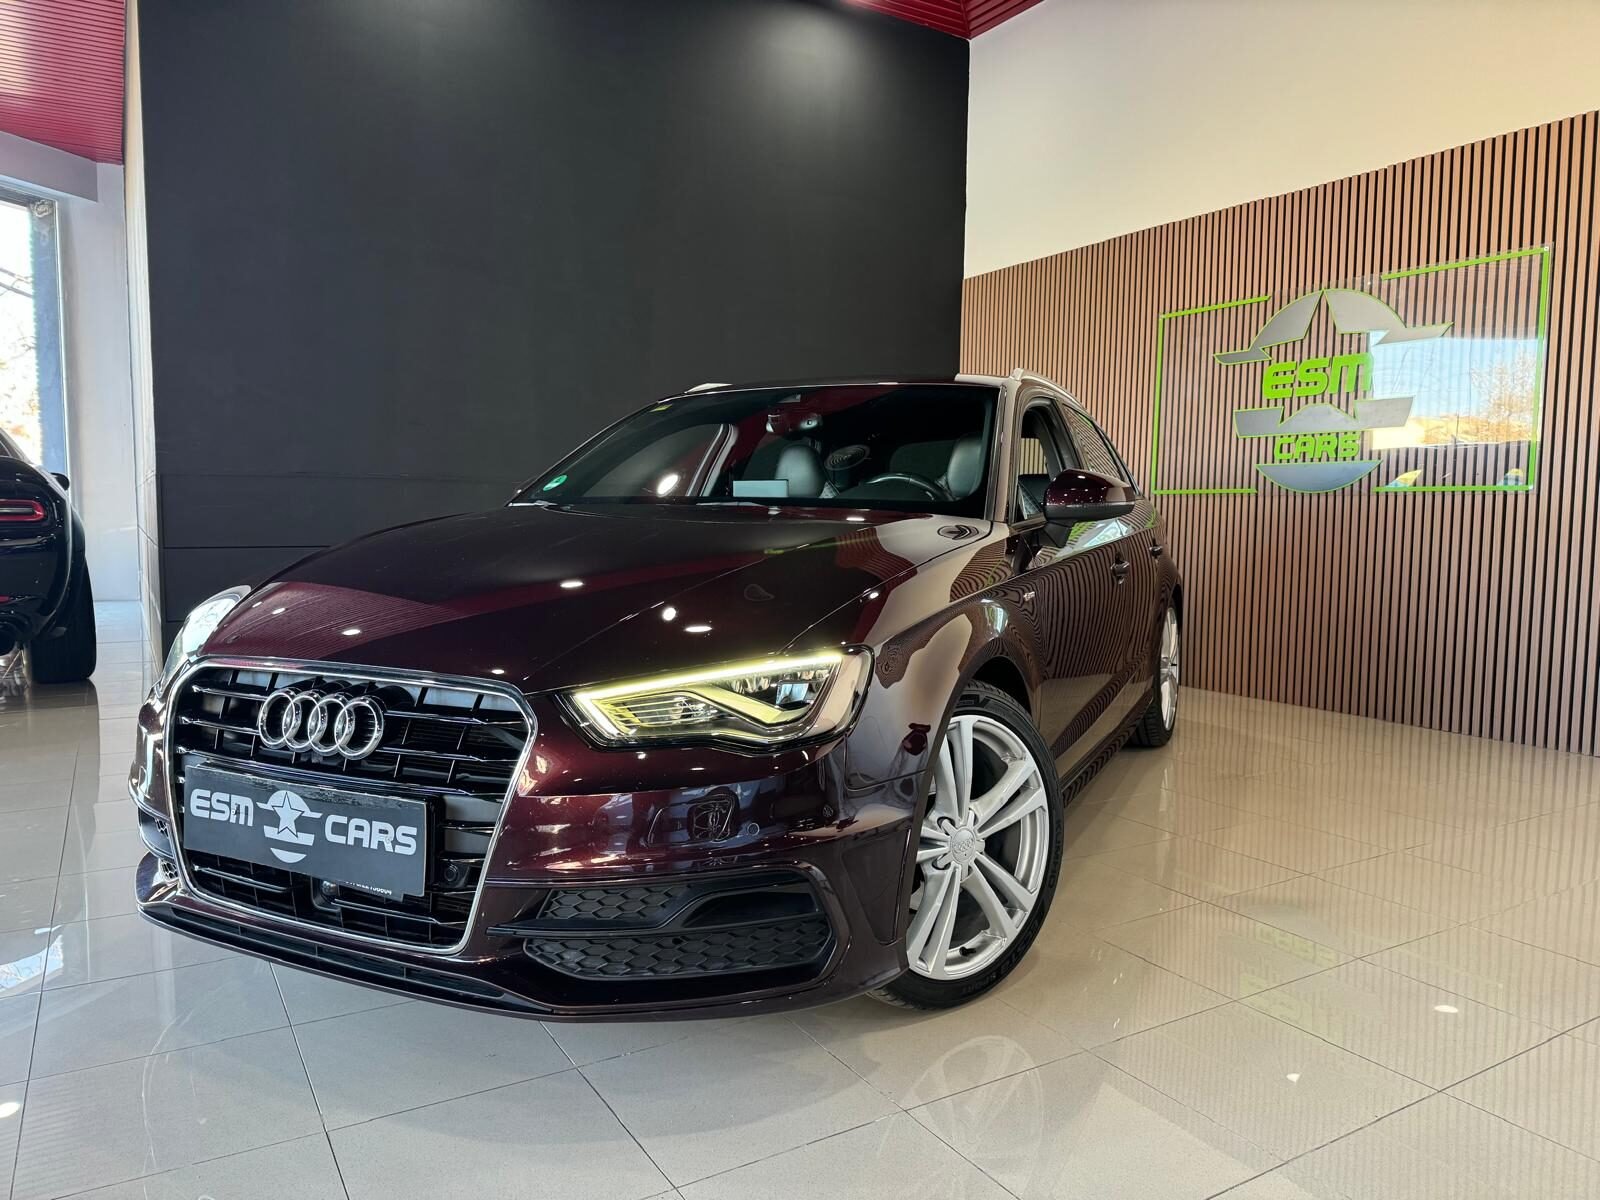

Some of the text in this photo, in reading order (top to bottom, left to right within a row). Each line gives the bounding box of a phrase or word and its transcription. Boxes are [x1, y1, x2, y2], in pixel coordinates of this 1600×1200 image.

[1264, 353, 1374, 399] ESM
[1274, 433, 1360, 460] CARS
[190, 789, 417, 856] ESM CARS
[1048, 820, 1062, 888] KUMHO
